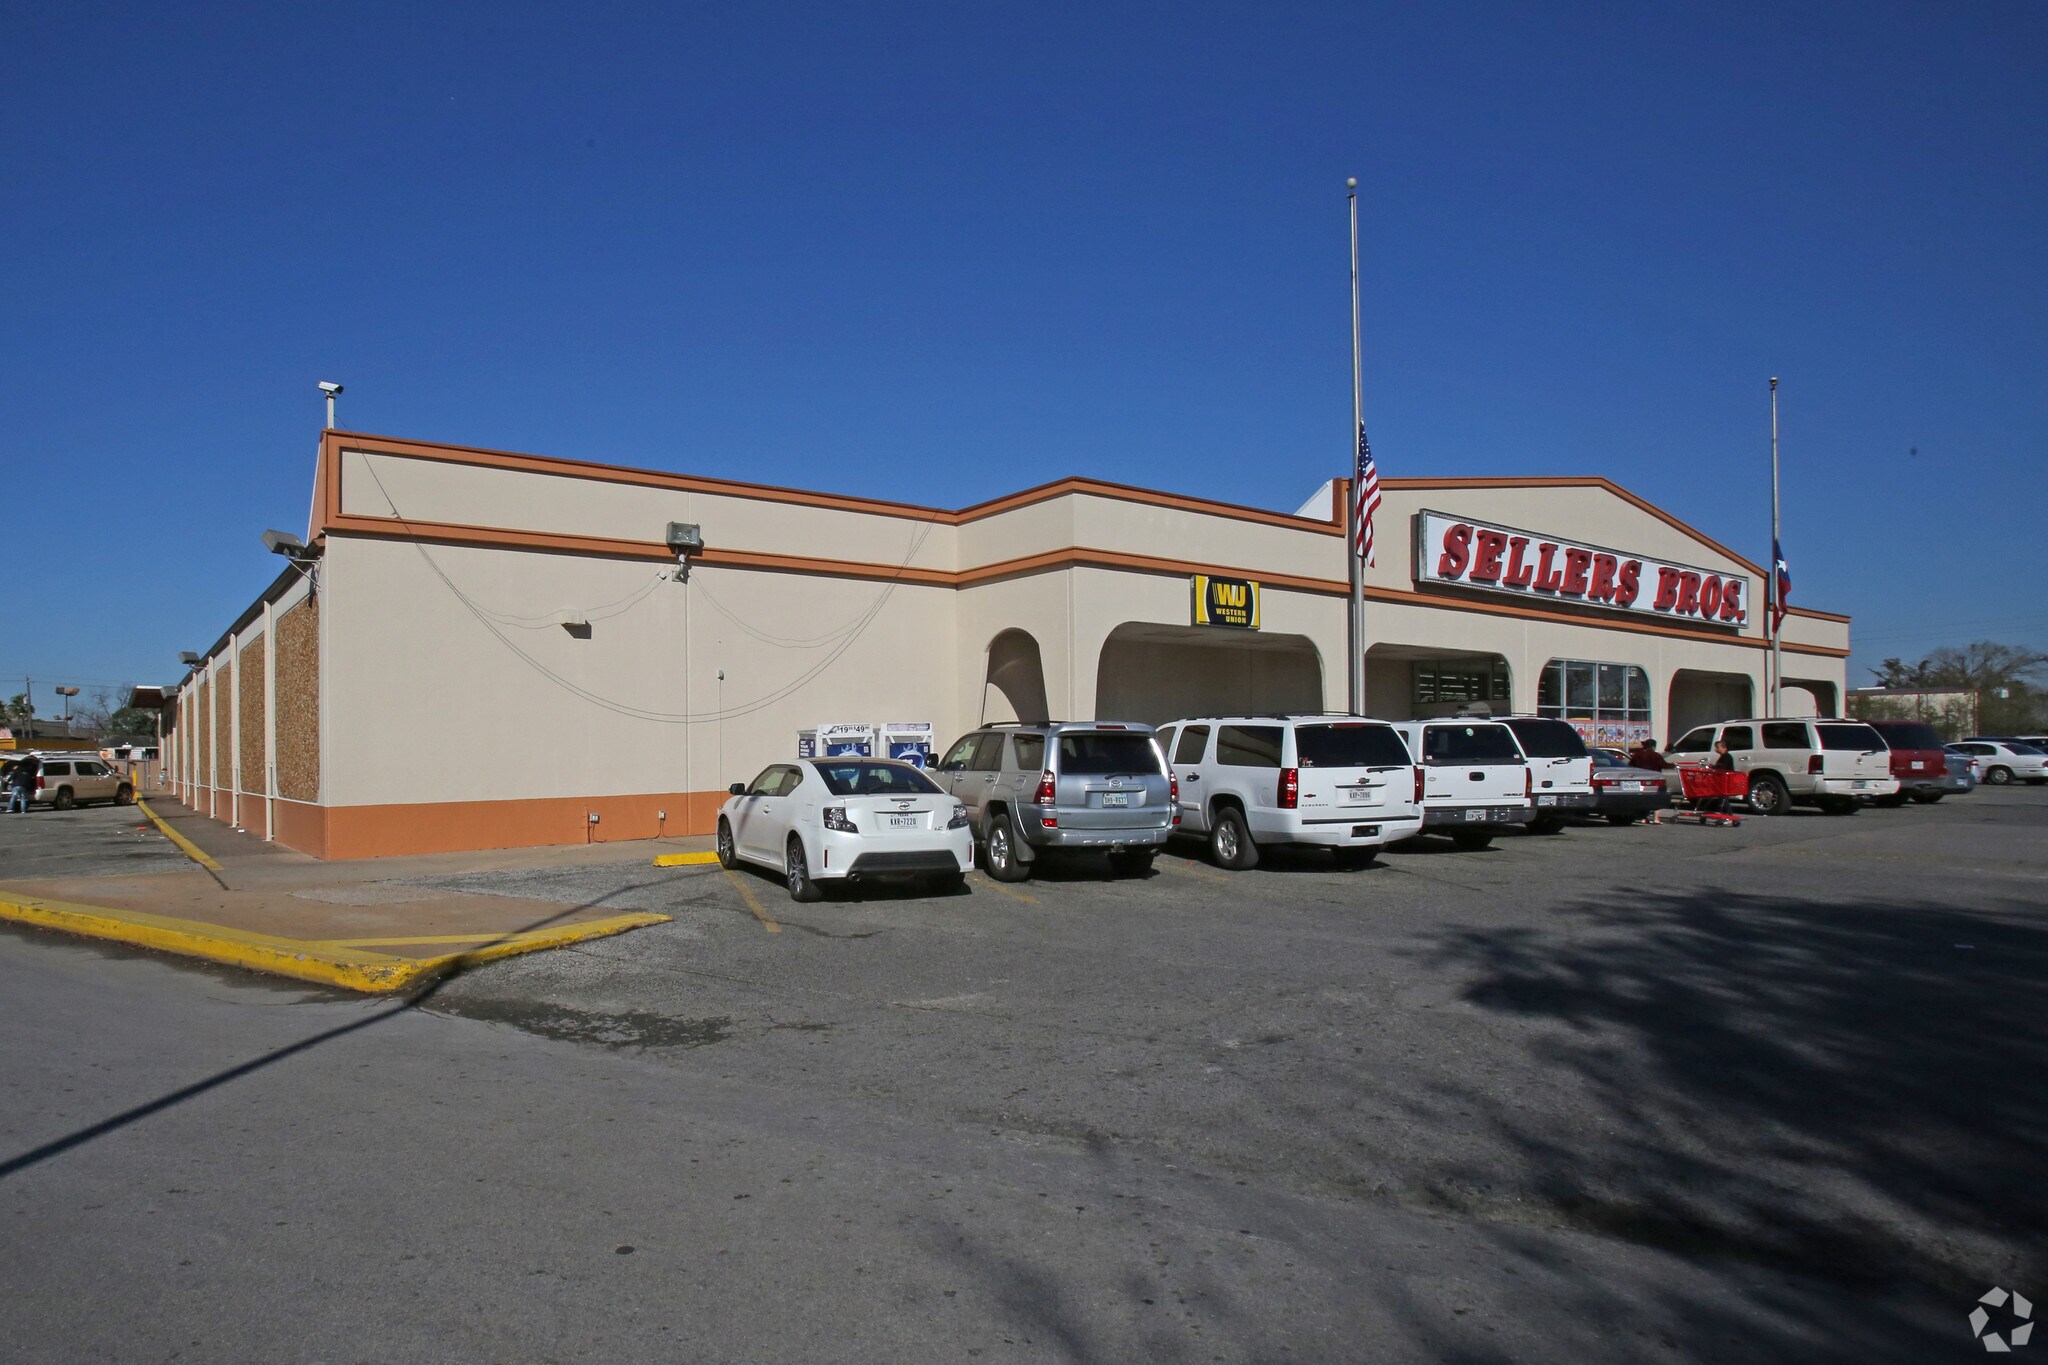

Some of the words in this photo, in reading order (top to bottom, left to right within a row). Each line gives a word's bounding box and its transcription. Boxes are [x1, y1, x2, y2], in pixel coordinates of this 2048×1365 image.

[1437, 523, 1642, 608] SELLERS
[1653, 566, 1746, 624] BROS.
[1212, 582, 1246, 608] WU
[1215, 607, 1247, 617] WESTERN
[1225, 616, 1247, 624] UNION
